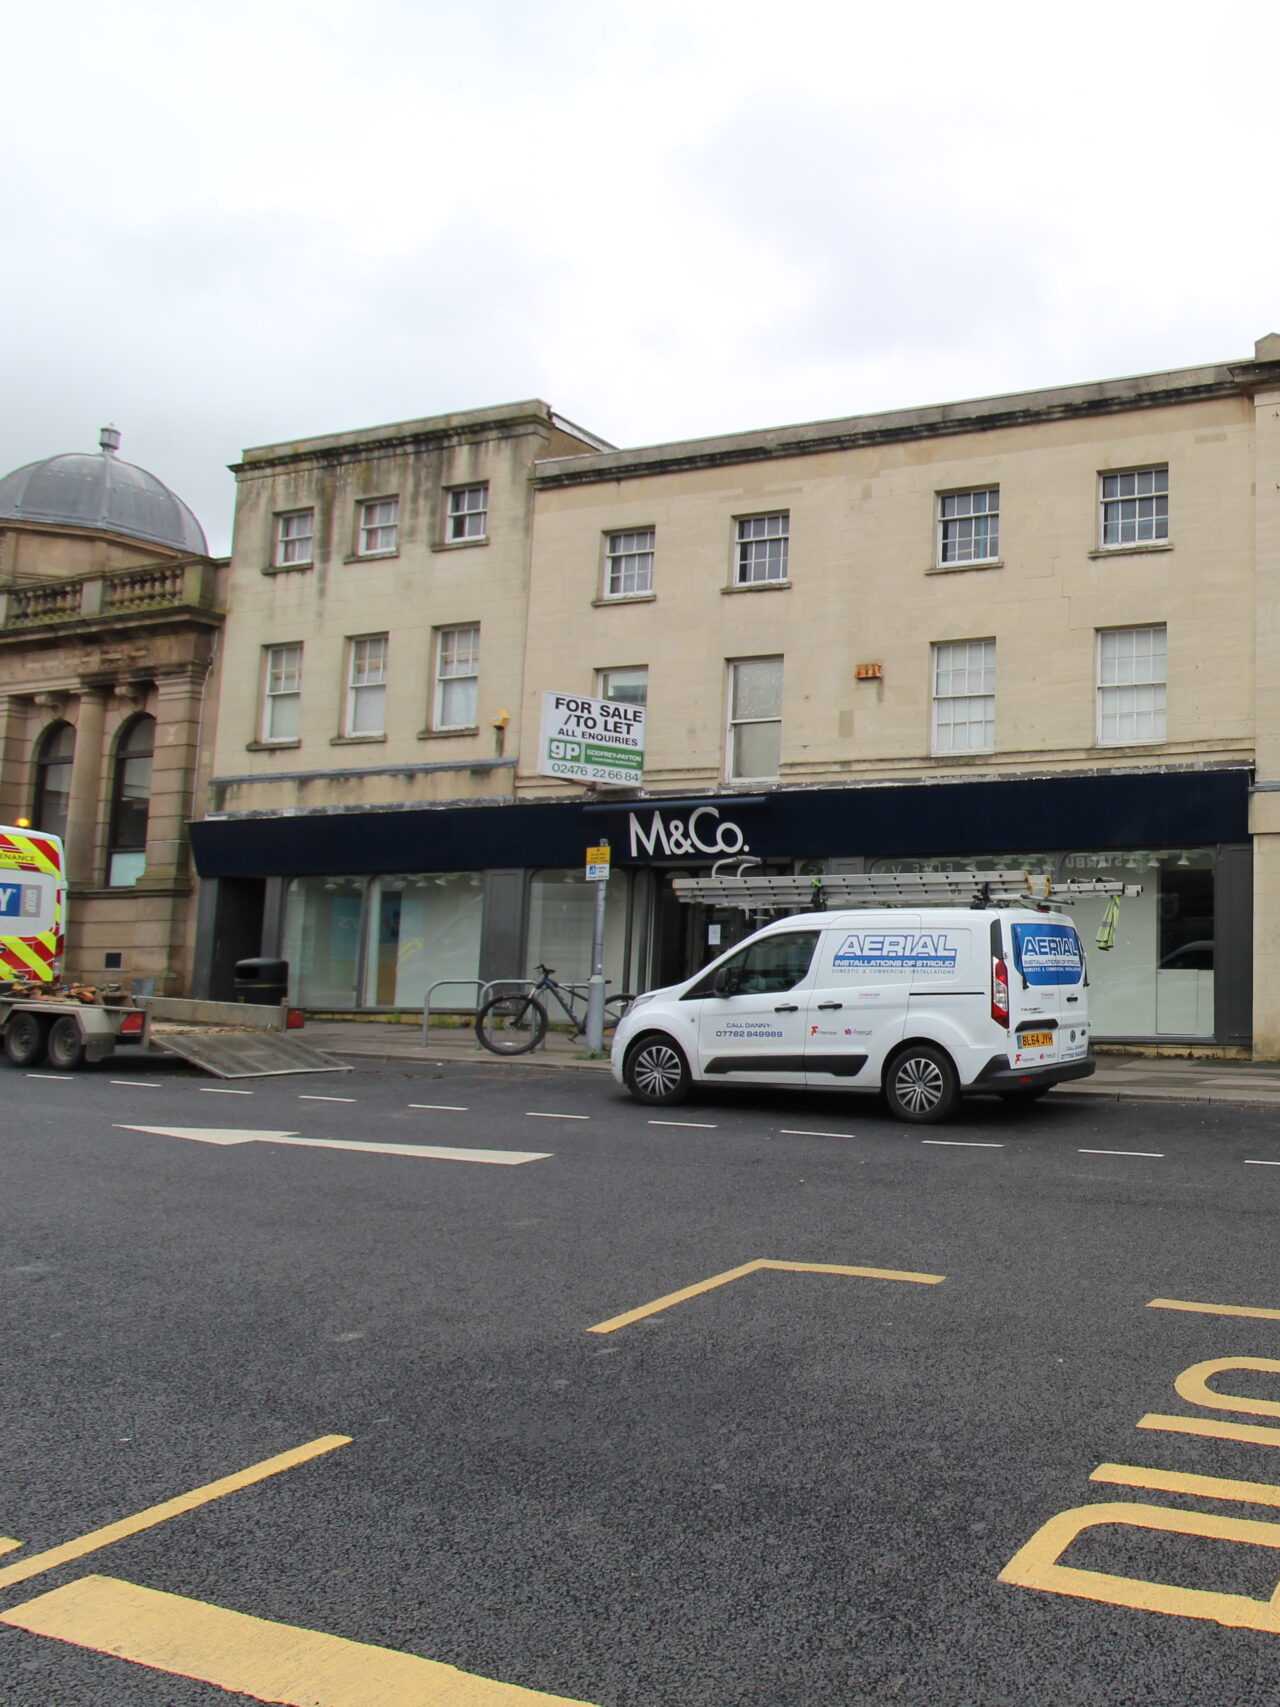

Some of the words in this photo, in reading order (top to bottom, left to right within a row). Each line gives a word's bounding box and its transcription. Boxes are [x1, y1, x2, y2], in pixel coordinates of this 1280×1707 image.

[555, 697, 592, 715] FOR
[600, 704, 643, 723] SALE
[603, 719, 634, 735] LET
[557, 727, 577, 738] ALL
[581, 731, 638, 747] ENQUIRIES
[550, 741, 580, 760] gp
[552, 762, 588, 776] 02476
[629, 806, 750, 857] M&Co.
[0, 852, 35, 862] ENANCE
[834, 935, 957, 957] AERIAL
[1023, 936, 1079, 957] AERIAL
[834, 959, 902, 967] INSTALLATIONS
[716, 1030, 745, 1038] 07782
[1022, 1034, 1039, 1046] BL64
